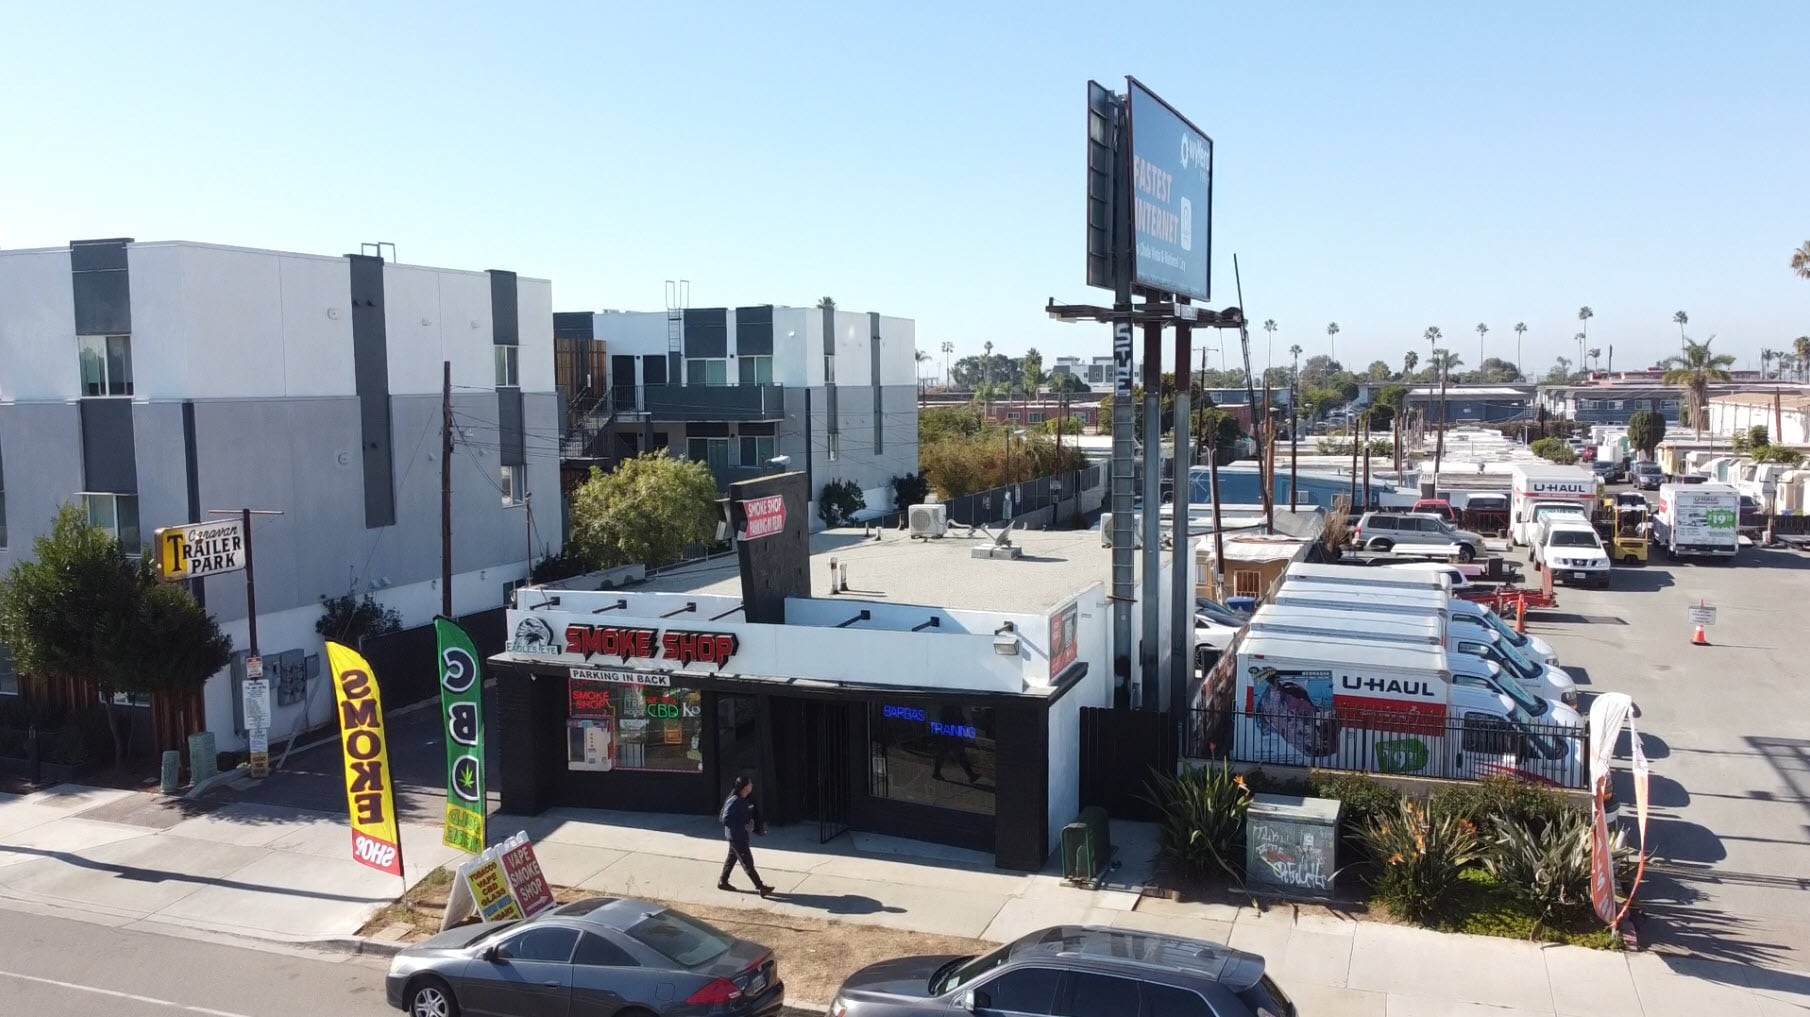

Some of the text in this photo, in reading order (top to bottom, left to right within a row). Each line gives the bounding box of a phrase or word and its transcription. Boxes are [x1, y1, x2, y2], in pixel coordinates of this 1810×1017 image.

[1134, 156, 1172, 204] FASTEST
[1135, 197, 1178, 245] INTERNET
[1534, 484, 1586, 492] U-HAUL
[748, 498, 781, 518] SMOKE SHOP
[189, 526, 237, 542] Caravan
[167, 534, 242, 571] TRAILER
[192, 553, 236, 574] PARK
[565, 624, 738, 671] SMOKE SHOP
[573, 669, 667, 685] PARKING IN BACK
[1342, 676, 1435, 697] U-HAUL
[573, 690, 608, 700] SMOKE
[576, 699, 605, 709] SHOP
[647, 704, 679, 718] CBD
[931, 722, 976, 739] TRAINING
[507, 846, 531, 869] VAPE
[469, 862, 497, 882] TOBACCO
[510, 861, 540, 888] SMOKE
[481, 888, 506, 906] GLASS
[520, 878, 543, 901] SHOP
